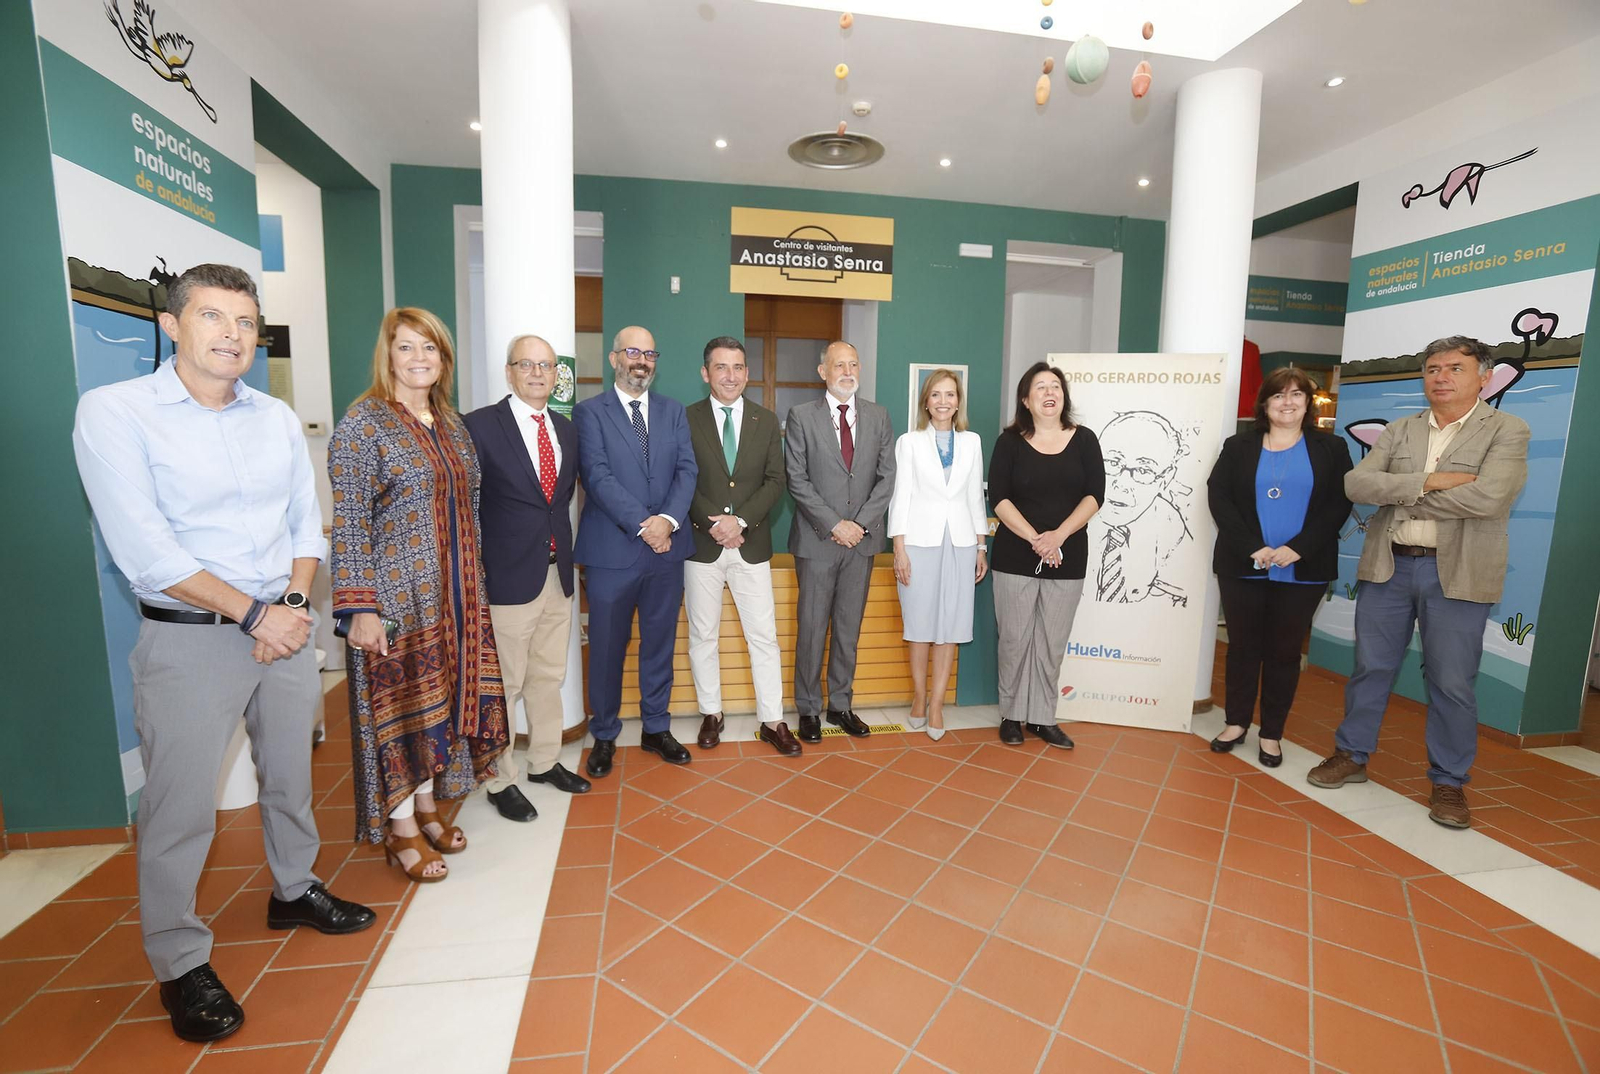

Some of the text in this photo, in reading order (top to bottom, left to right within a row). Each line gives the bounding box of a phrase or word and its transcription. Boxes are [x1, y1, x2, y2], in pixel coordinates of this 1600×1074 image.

[131, 112, 211, 174] espacios
[134, 145, 213, 202] naturales
[135, 170, 216, 223] de andalucía
[773, 239, 853, 253] Centro de visitantes
[1433, 243, 1486, 265] Tienda
[739, 249, 883, 272] Anastasio Senra
[1369, 257, 1420, 276] espacios
[1431, 241, 1566, 279] Anastasio Senra
[1366, 281, 1417, 298] de andalucía
[1367, 271, 1418, 288] naturales
[1286, 290, 1312, 301] Tienda
[1064, 372, 1221, 384] ORO GERARDO ROJAS
[1067, 642, 1161, 663] Huelva Información
[871, 725, 902, 733] GURIDAD
